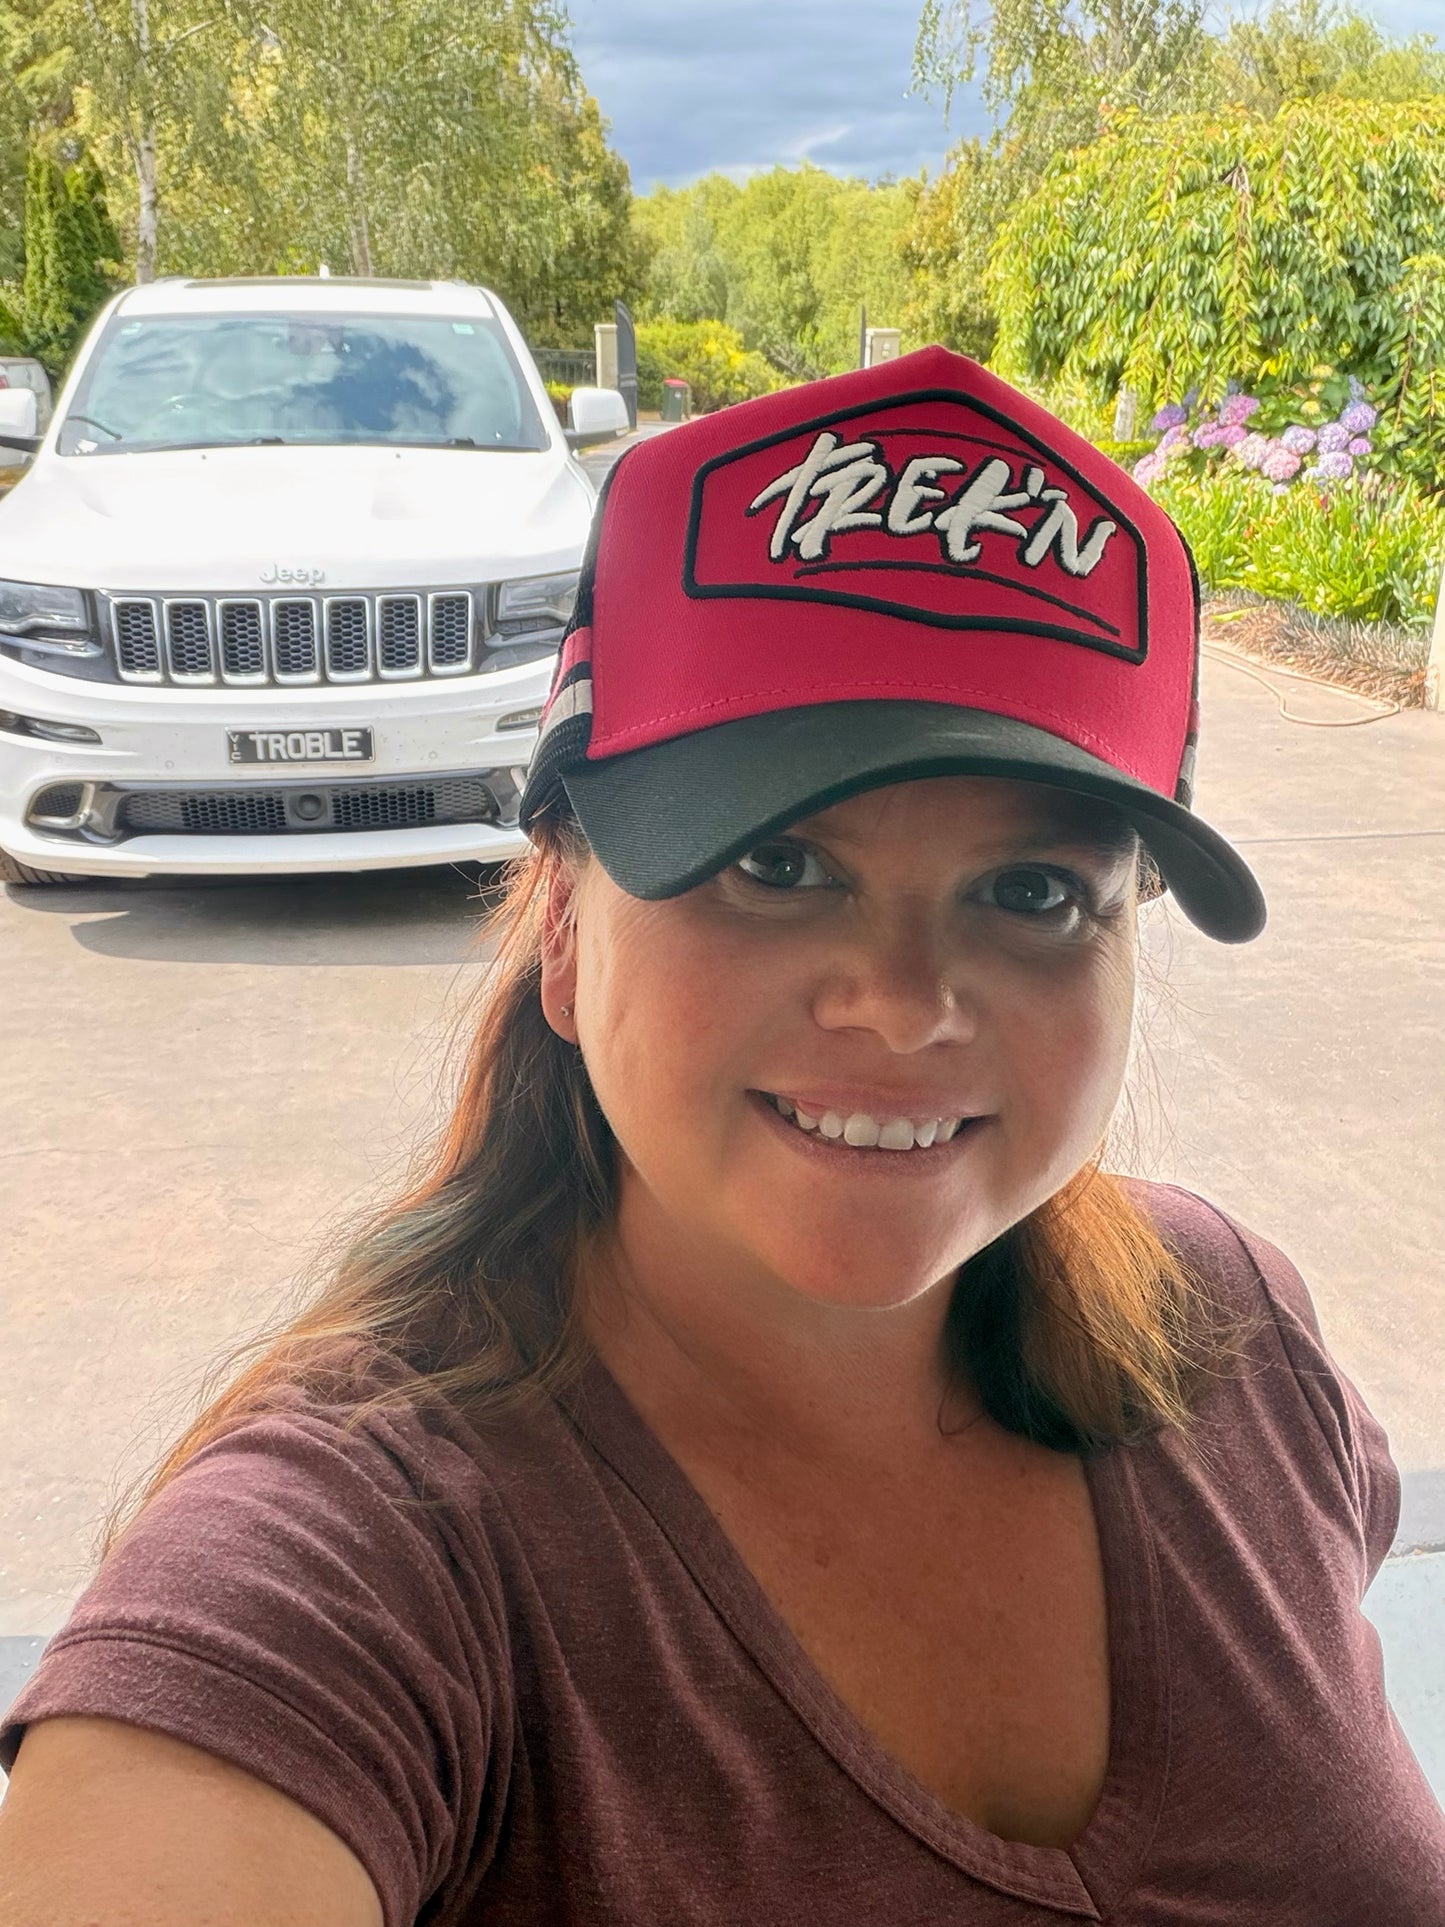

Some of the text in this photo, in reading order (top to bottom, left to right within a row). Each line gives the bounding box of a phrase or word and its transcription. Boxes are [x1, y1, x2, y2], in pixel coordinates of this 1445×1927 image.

[748, 431, 1118, 577] TREK'N
[258, 562, 325, 587] Jeep
[229, 733, 242, 761] VIC
[248, 731, 364, 761] TROBLE
